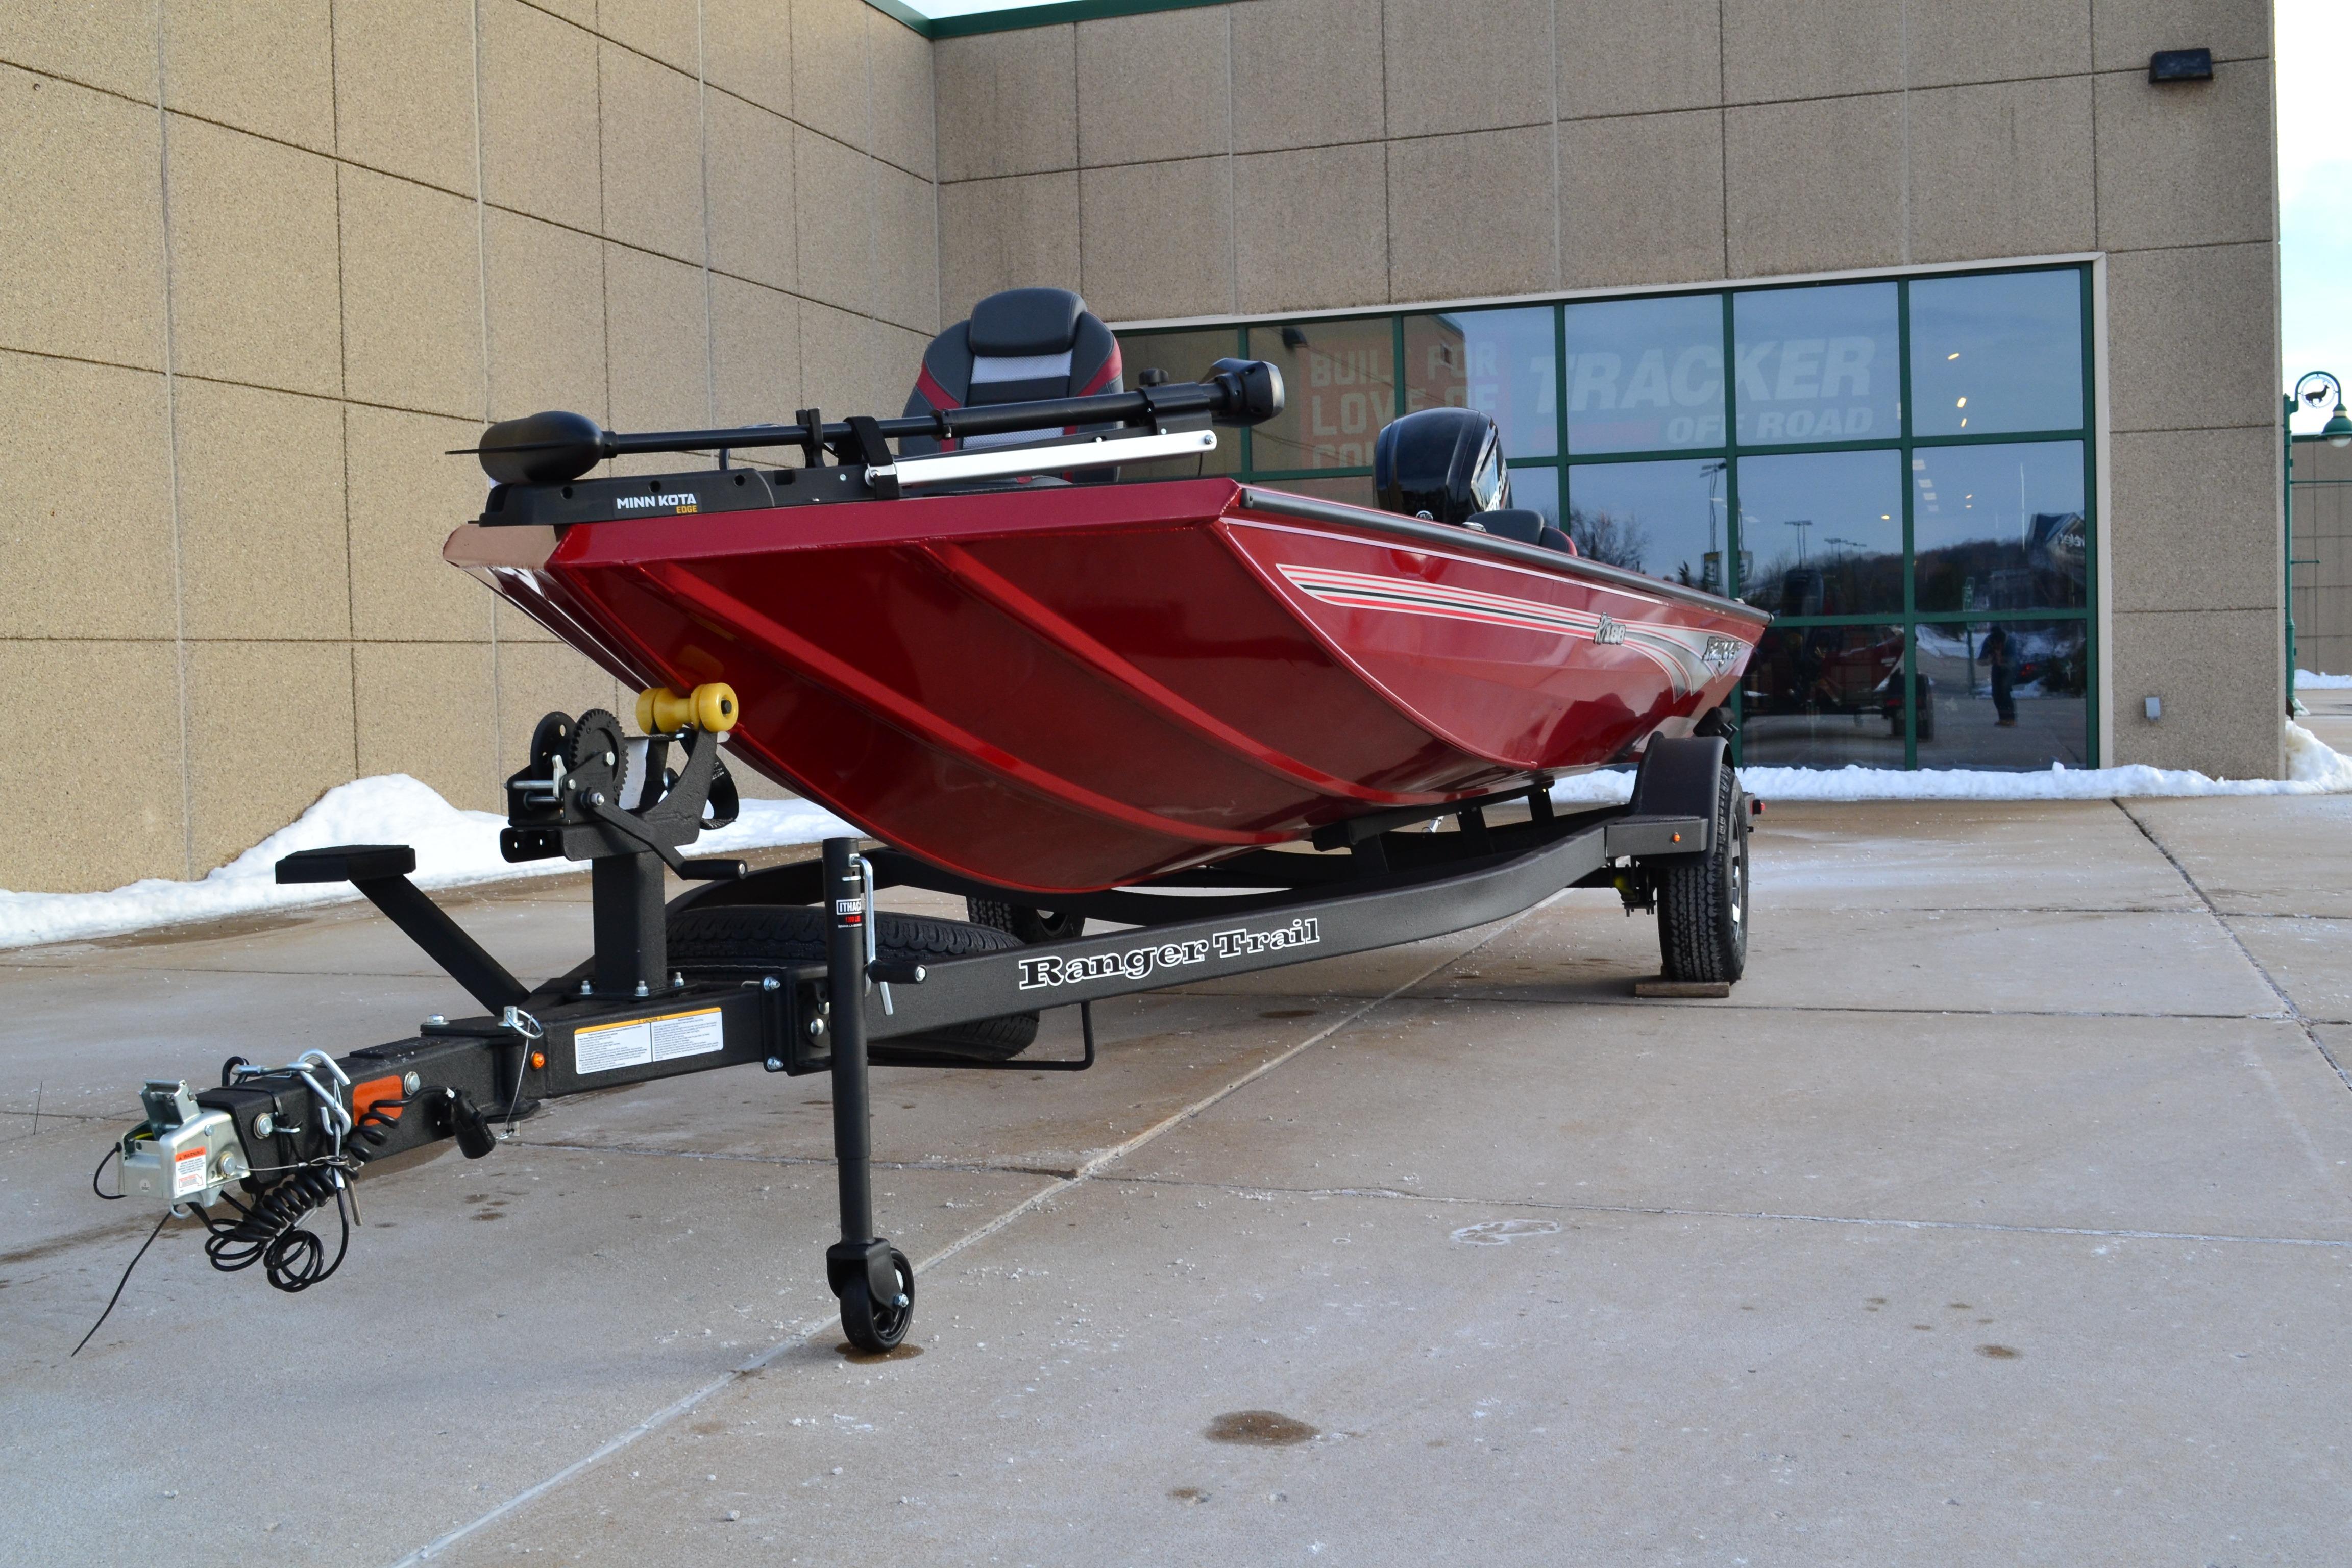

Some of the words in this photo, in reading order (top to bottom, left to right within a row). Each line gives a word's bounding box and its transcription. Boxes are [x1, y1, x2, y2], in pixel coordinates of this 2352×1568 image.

[1428, 341, 1498, 380] FOR
[1529, 336, 1876, 414] TRACKER
[1756, 407, 1873, 440] ROAD
[617, 495, 655, 509] MINN
[658, 493, 697, 506] KOTA
[676, 505, 698, 513] EDGE
[1018, 938, 1209, 990] Ranger
[1213, 917, 1320, 959] Trail
